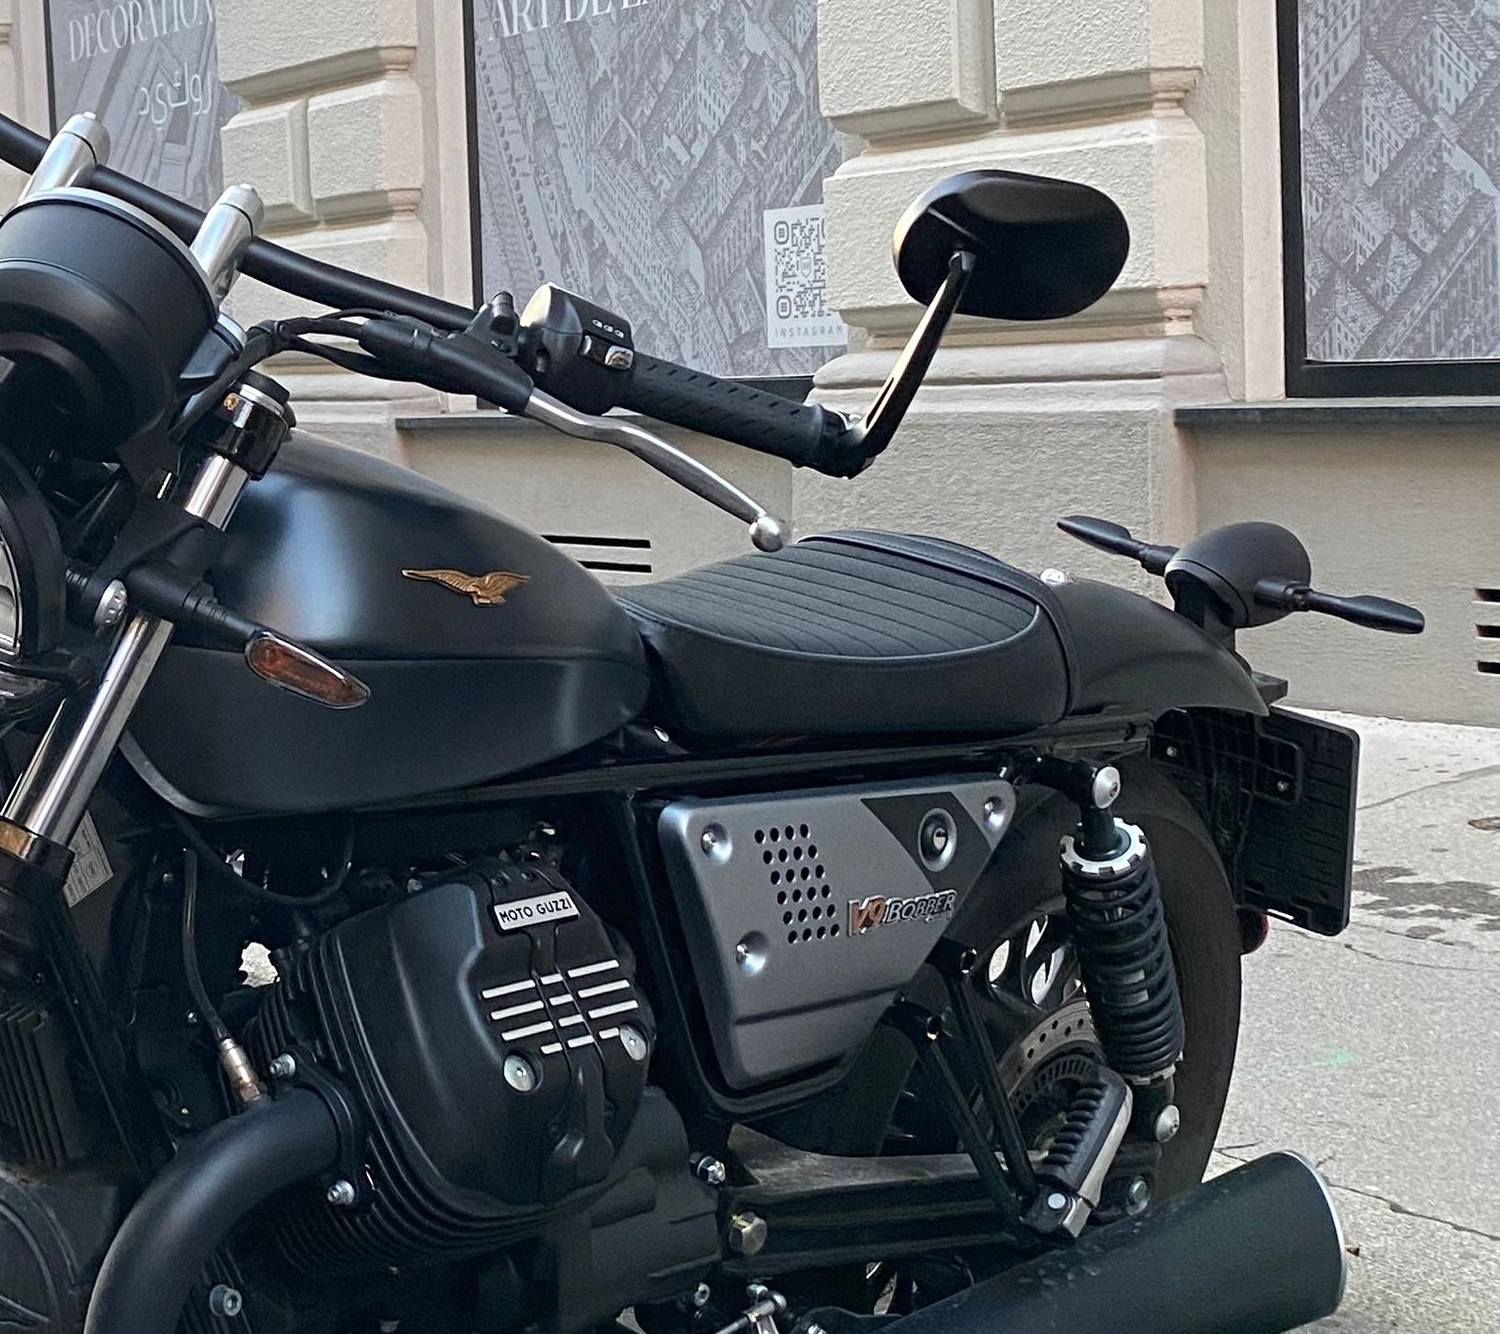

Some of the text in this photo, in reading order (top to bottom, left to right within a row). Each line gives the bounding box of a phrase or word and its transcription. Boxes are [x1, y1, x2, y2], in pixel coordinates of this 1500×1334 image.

[774, 325, 844, 339] INSTAGRAM
[498, 897, 573, 924] MOTO GUZZI
